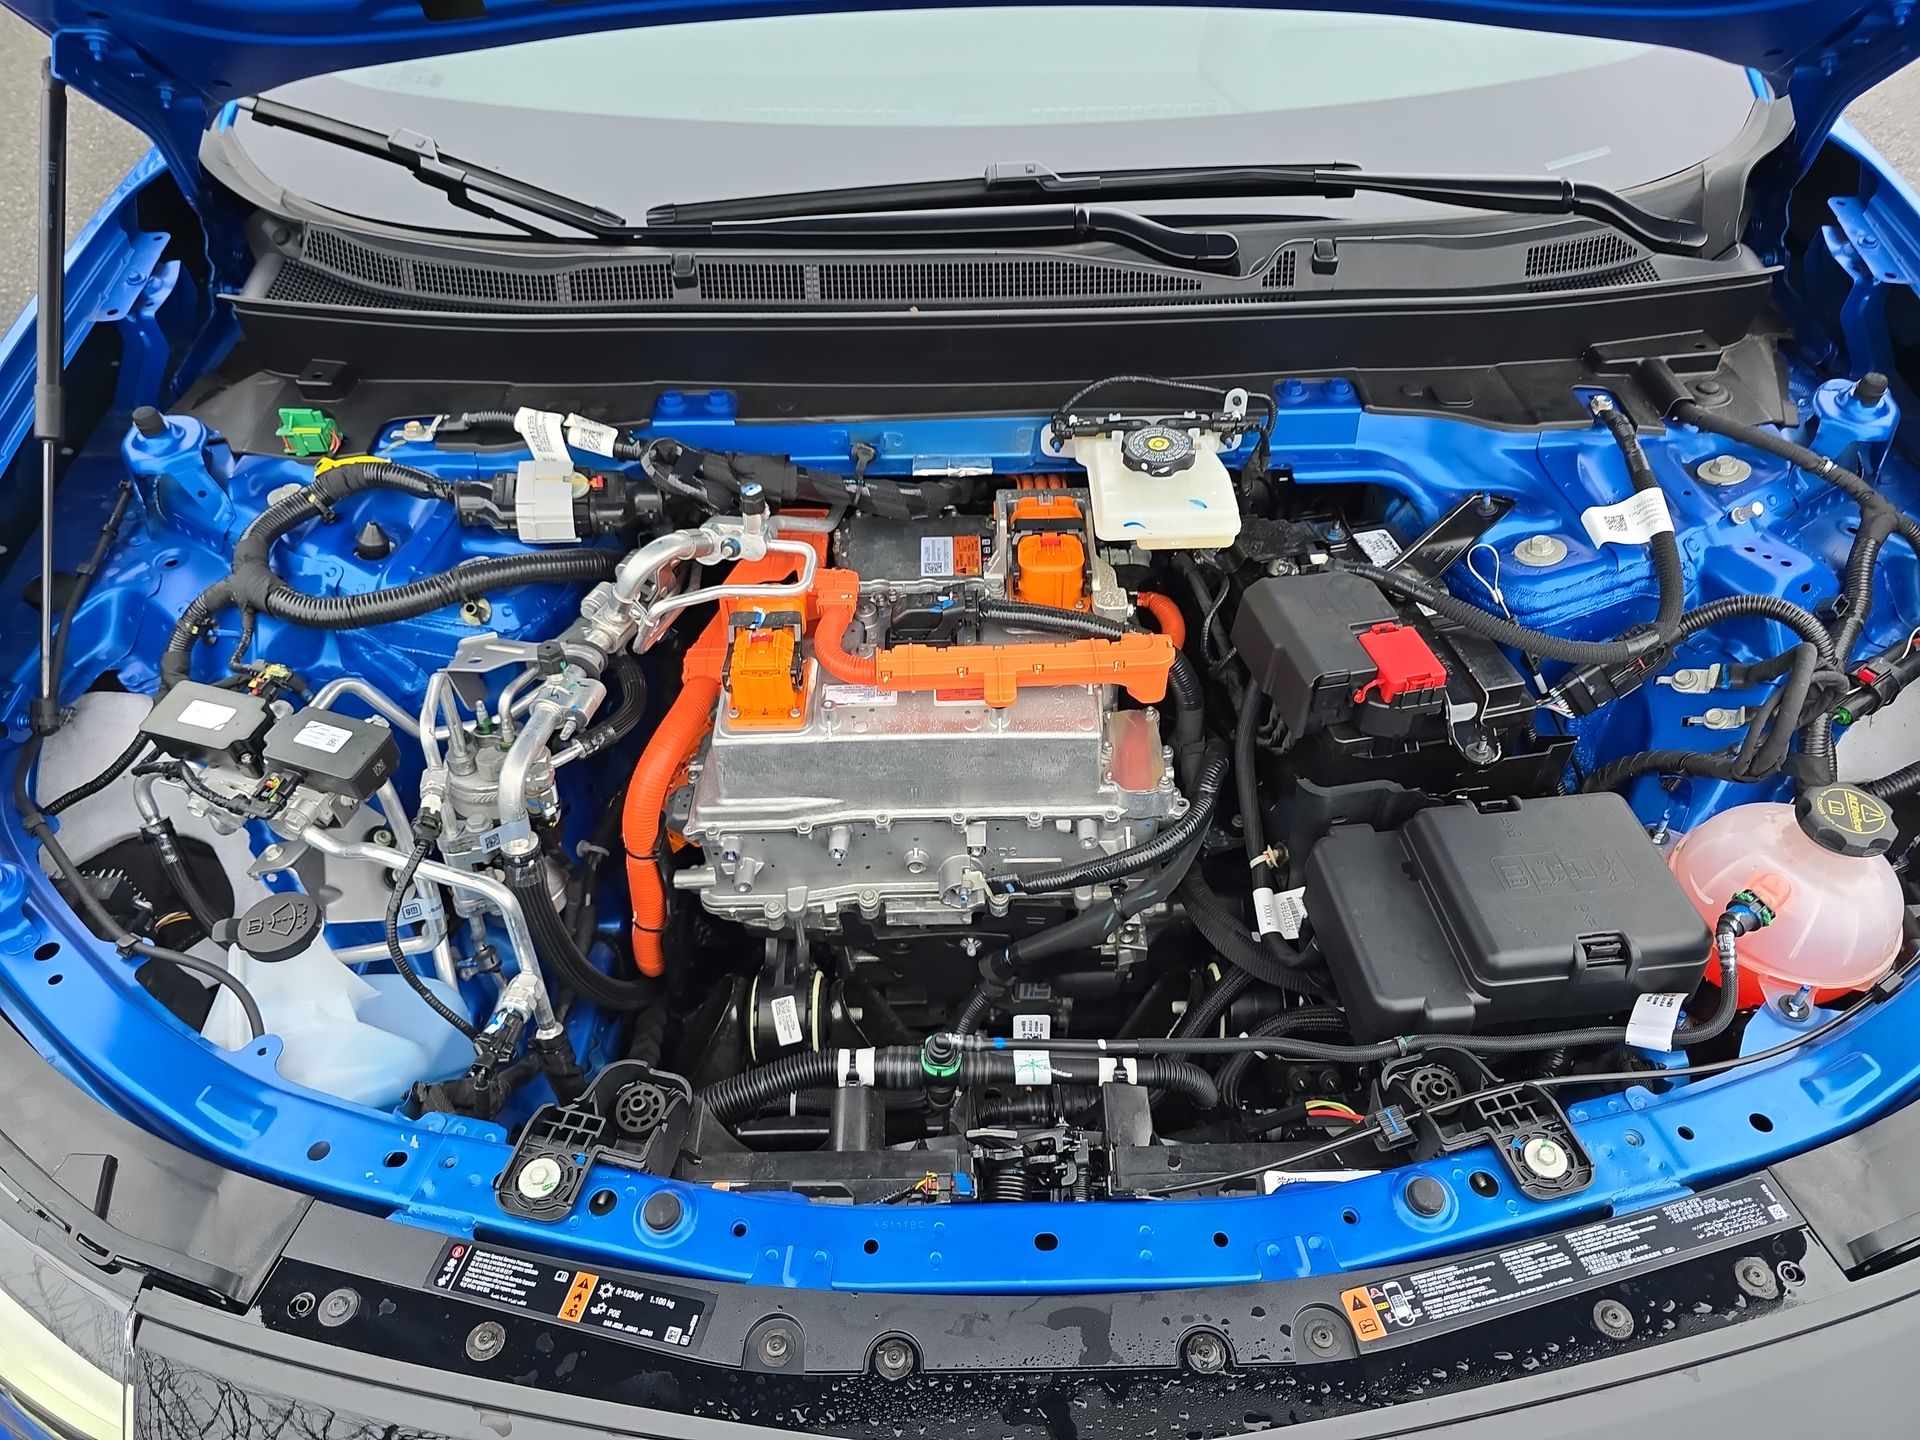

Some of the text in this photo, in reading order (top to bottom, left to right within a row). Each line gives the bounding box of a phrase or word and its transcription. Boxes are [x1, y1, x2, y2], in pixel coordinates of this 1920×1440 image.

[1847, 792, 1863, 832] ACDelco
[615, 1287, 644, 1302] R-1234yf
[606, 1308, 622, 1319] POE
